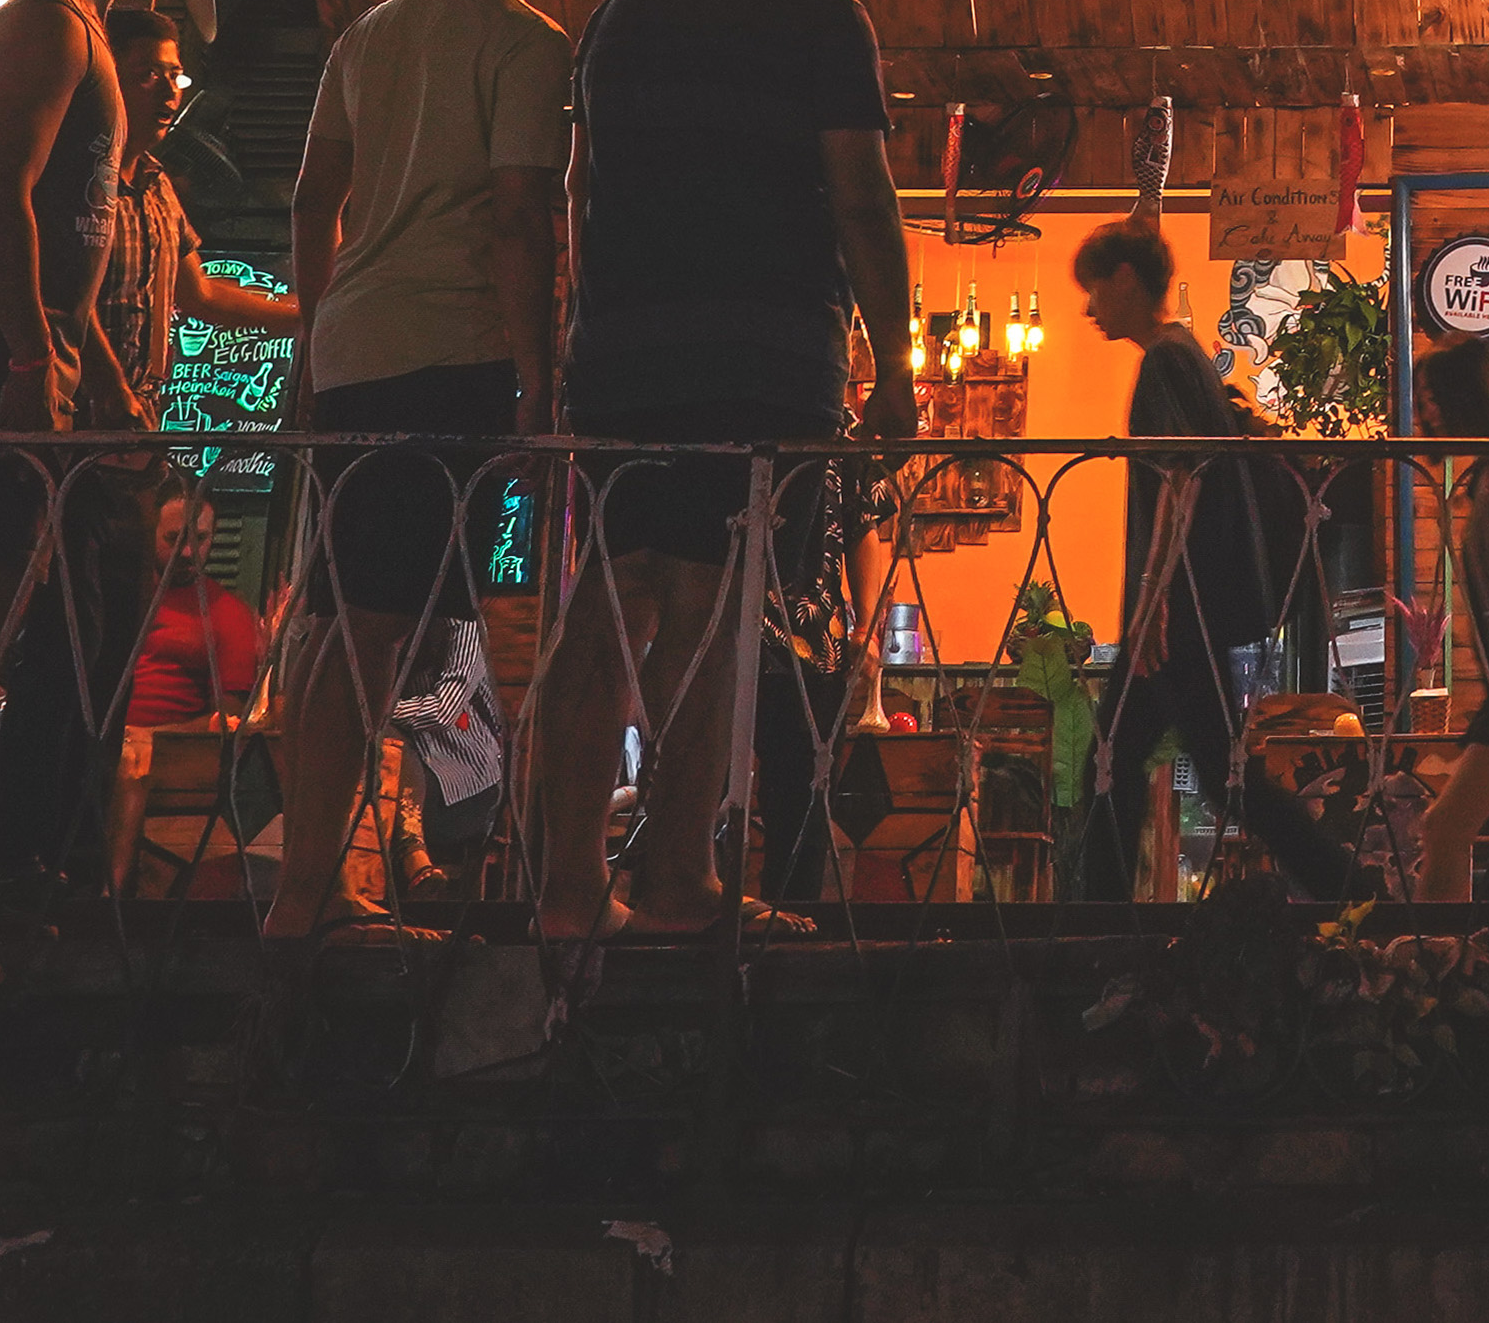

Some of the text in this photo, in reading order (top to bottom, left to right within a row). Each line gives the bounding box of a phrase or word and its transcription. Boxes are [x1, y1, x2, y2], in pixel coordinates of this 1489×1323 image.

[1219, 188, 1245, 206] Air
[1445, 274, 1482, 288] FREE
[213, 346, 253, 365] EGG
[172, 362, 210, 380] BEER
[168, 378, 237, 399] Heineken
